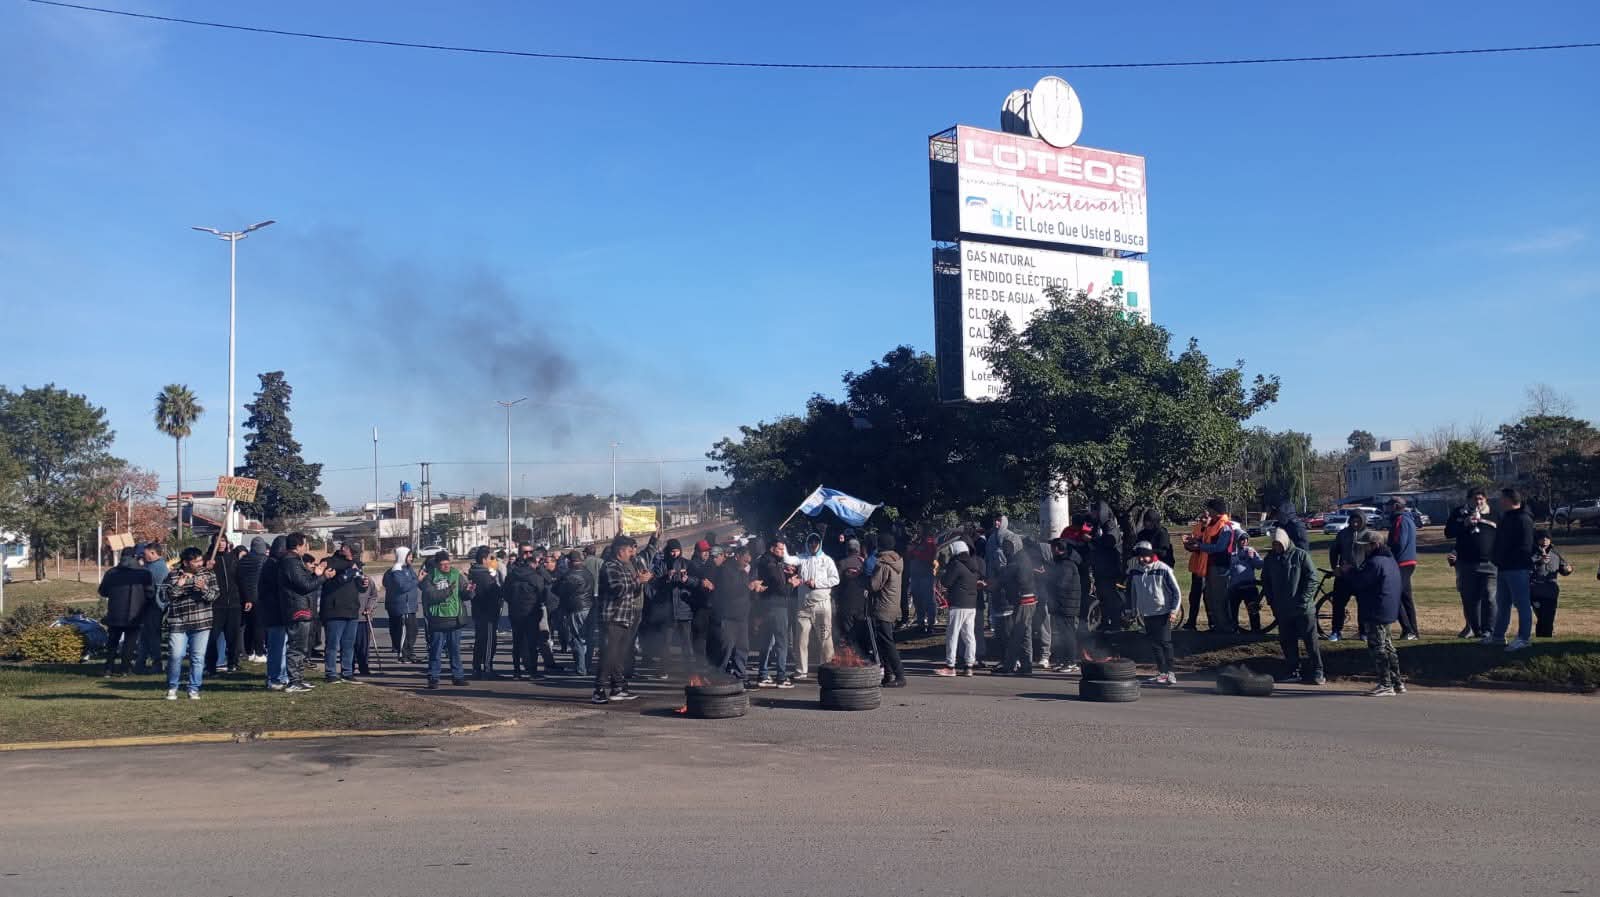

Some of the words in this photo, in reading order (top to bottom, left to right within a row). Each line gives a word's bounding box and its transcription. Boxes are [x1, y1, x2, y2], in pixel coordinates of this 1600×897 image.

[965, 140, 1142, 189] LOTEOS
[1016, 215, 1027, 232] El
[1030, 217, 1054, 235] Lote
[1058, 221, 1078, 238] Que
[1081, 223, 1111, 242] Usted
[1114, 229, 1144, 246] Busca
[966, 249, 987, 263] GAS
[990, 252, 1036, 268] NATURAL
[967, 268, 1013, 284] TENDIDO
[967, 287, 989, 301] RED
[991, 289, 1005, 303] DE
[1008, 291, 1035, 305] AGUA
